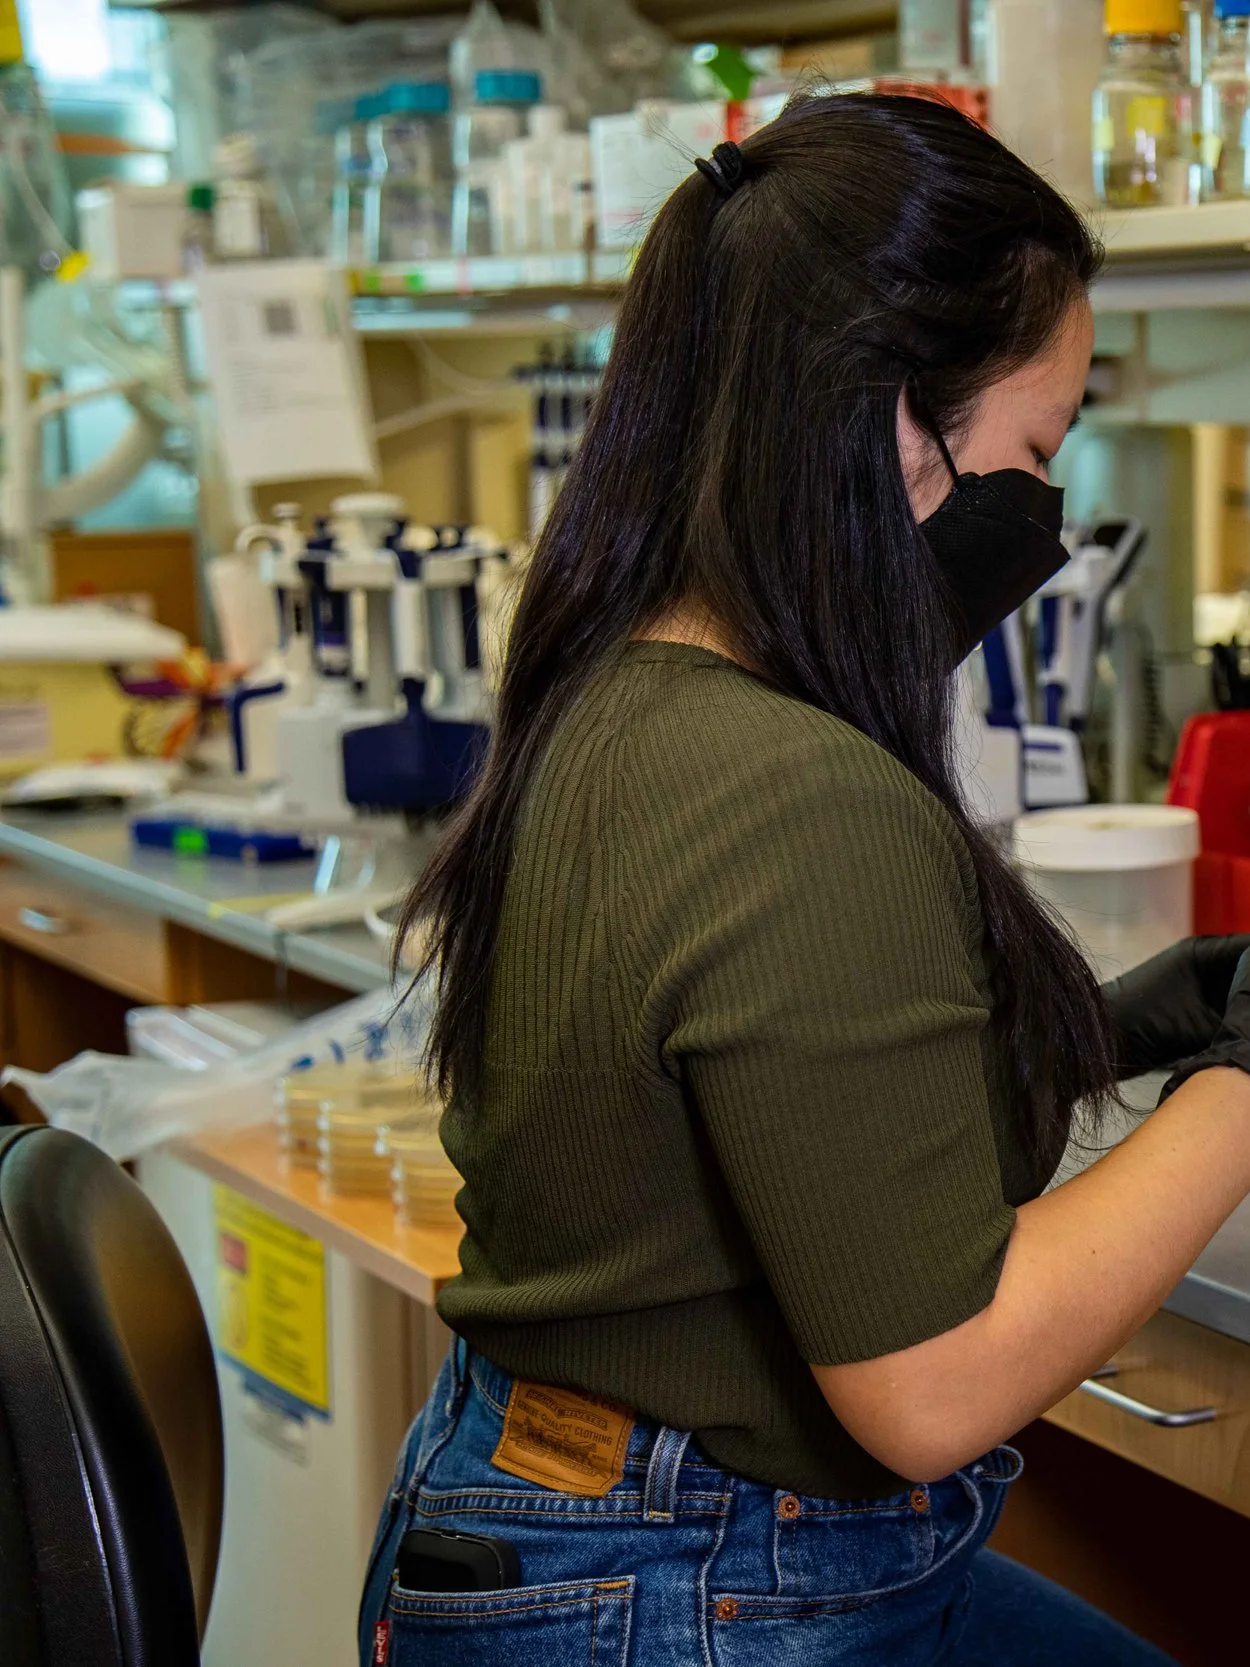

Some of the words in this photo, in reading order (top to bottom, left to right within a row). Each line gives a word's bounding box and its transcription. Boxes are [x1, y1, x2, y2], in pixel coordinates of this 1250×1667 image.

[541, 1413, 572, 1432] QUALITY
[574, 1424, 613, 1446] CLOTHING
[559, 1408, 607, 1429] RIVETED
